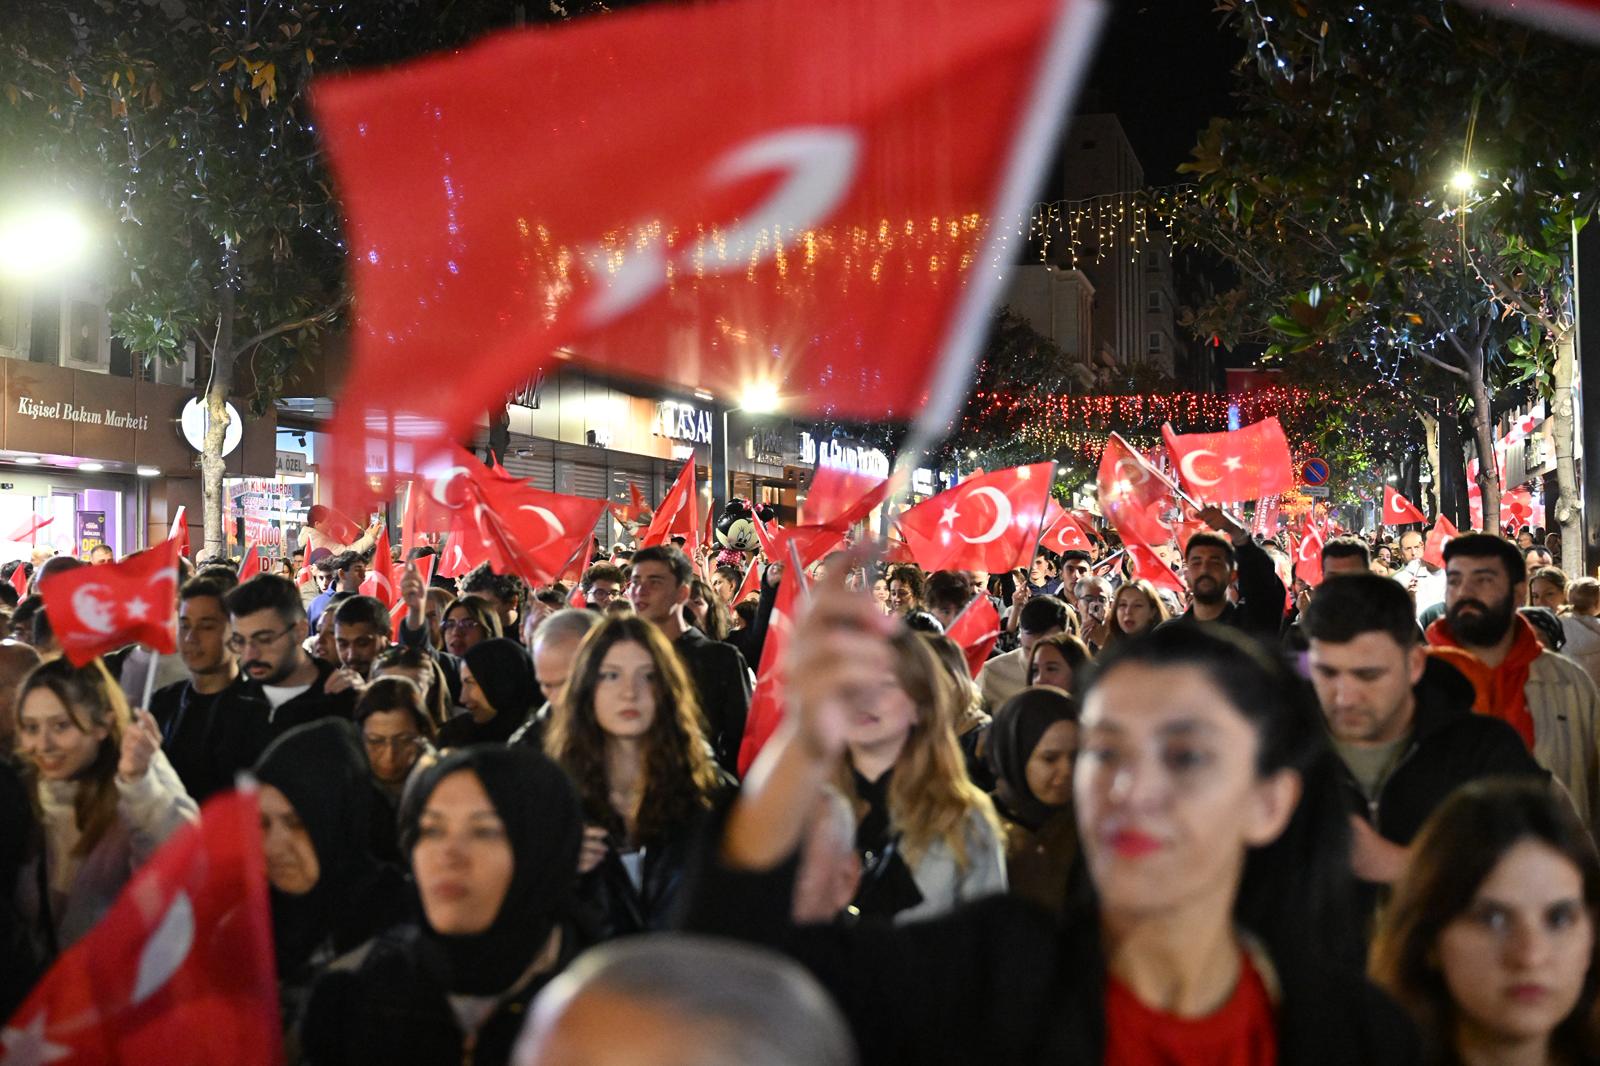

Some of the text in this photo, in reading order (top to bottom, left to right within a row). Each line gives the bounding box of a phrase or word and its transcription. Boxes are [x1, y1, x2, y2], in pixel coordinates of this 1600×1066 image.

[18, 396, 148, 430] Kişisel Bakım Marketi
[286, 454, 303, 472] ÖZEL
